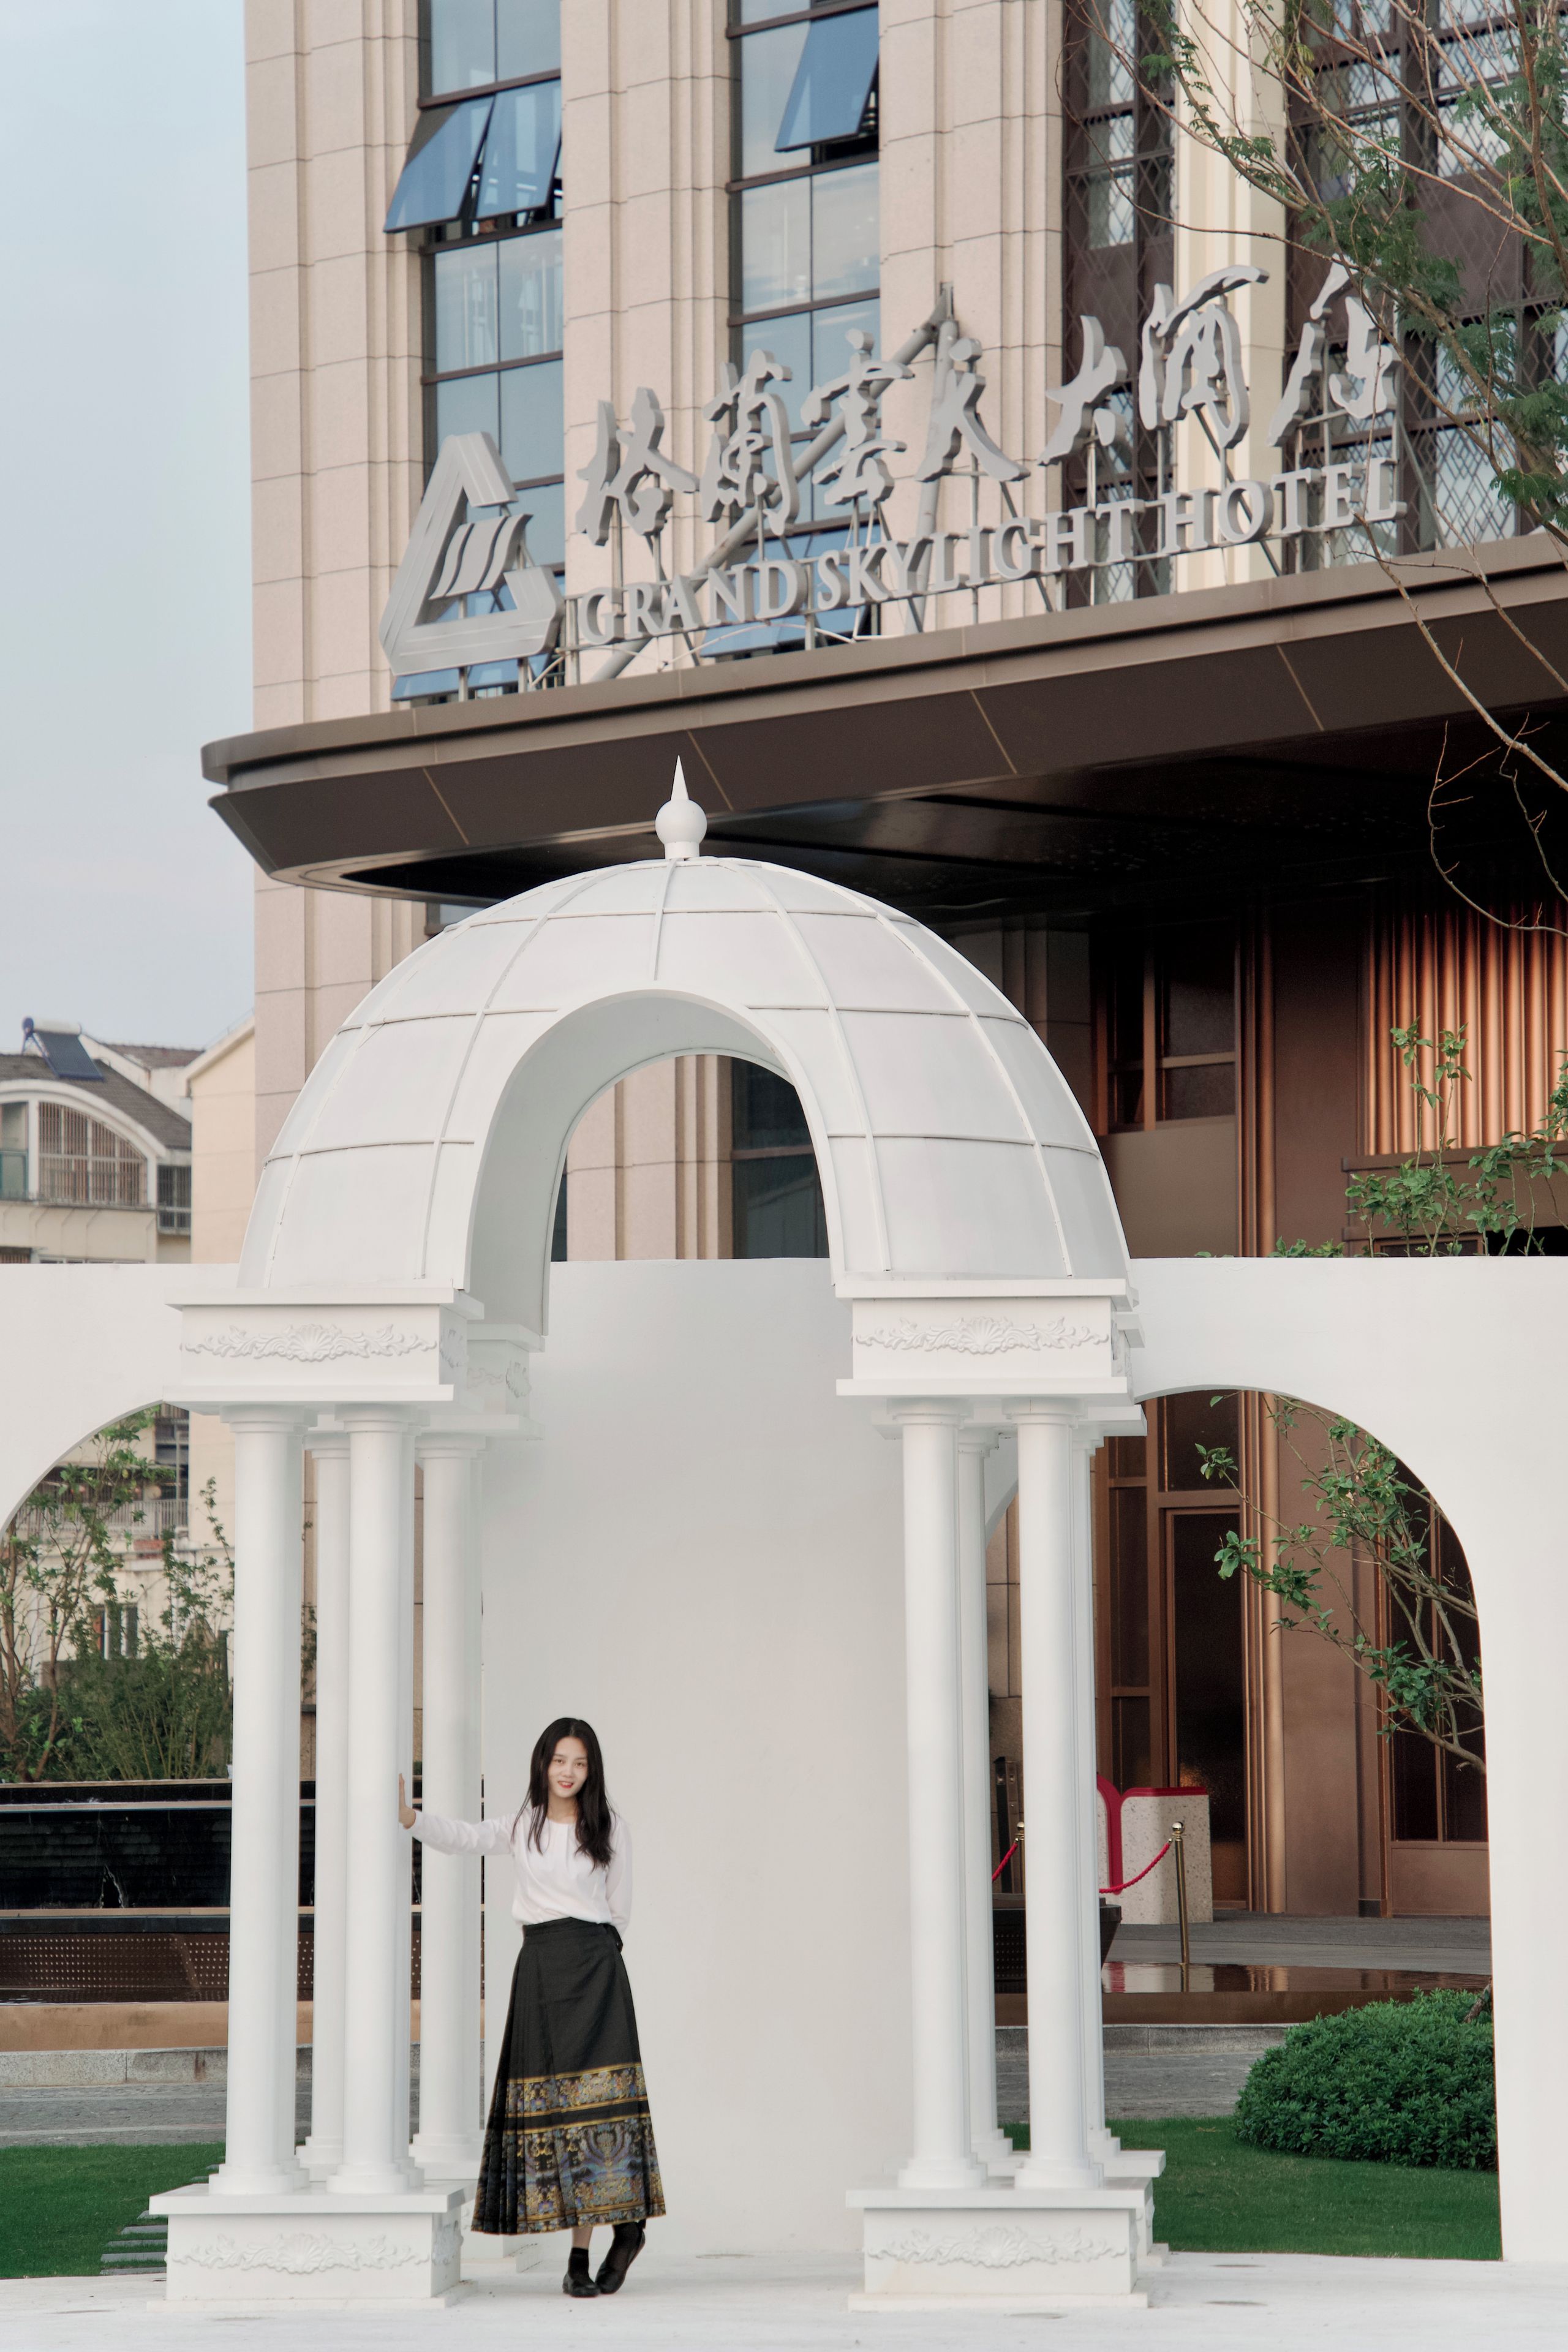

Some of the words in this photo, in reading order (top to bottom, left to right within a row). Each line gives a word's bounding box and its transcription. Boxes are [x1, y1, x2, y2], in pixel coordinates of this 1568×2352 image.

[578, 559, 809, 646] GRAND
[818, 499, 1145, 612] SKYLIGHT
[1161, 457, 1408, 554] HOTEL
